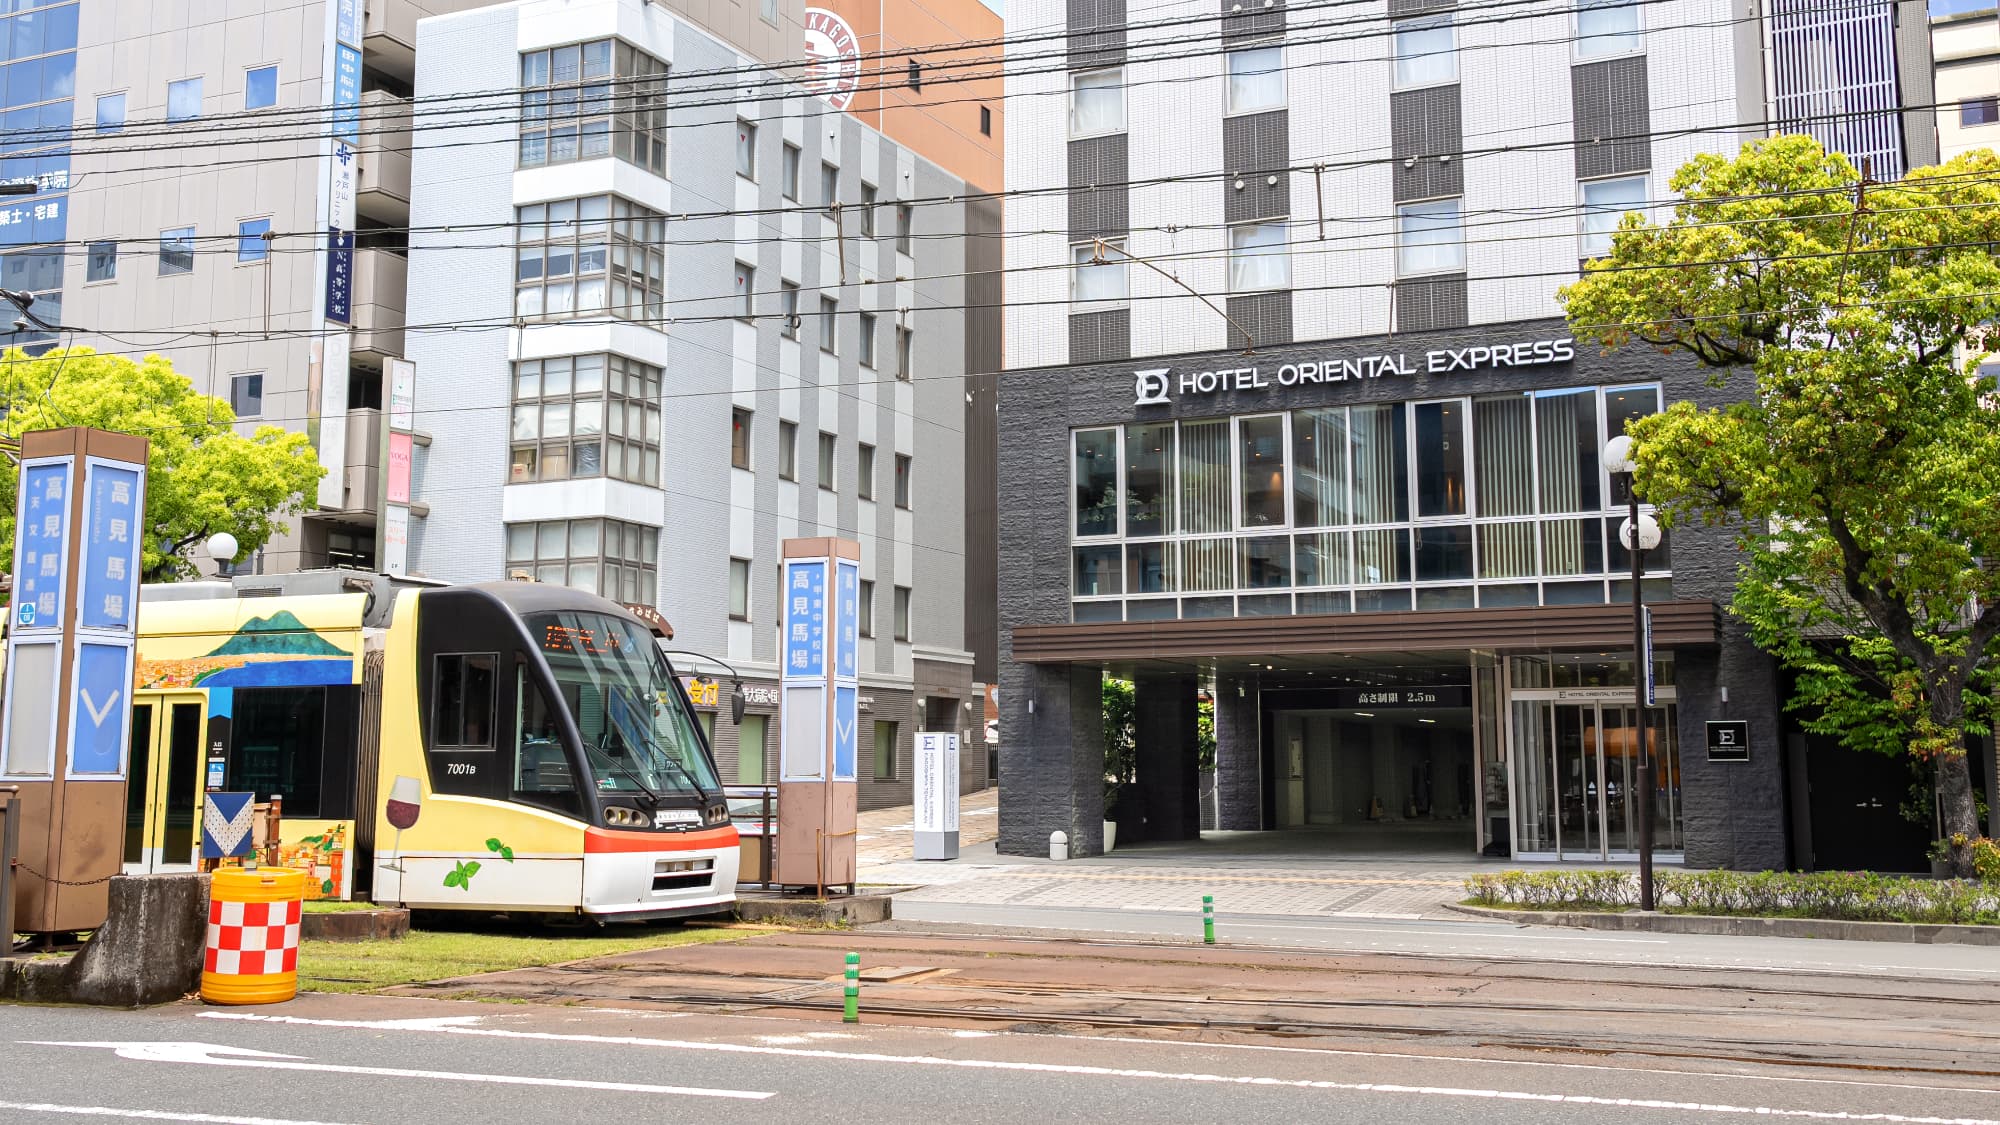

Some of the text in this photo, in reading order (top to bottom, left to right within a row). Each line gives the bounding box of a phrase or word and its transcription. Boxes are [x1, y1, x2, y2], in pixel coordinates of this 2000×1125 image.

[809, 13, 856, 104] KAGOSHIM
[1179, 338, 1574, 395] HOTEL ORIENTAL EXPRESS
[38, 477, 63, 616] 高見馬場
[103, 480, 130, 619] 高見馬場
[792, 570, 809, 669] 高見馬場
[1358, 692, 1436, 703] 高さ制限 2.5m
[447, 763, 476, 775] 7001B
